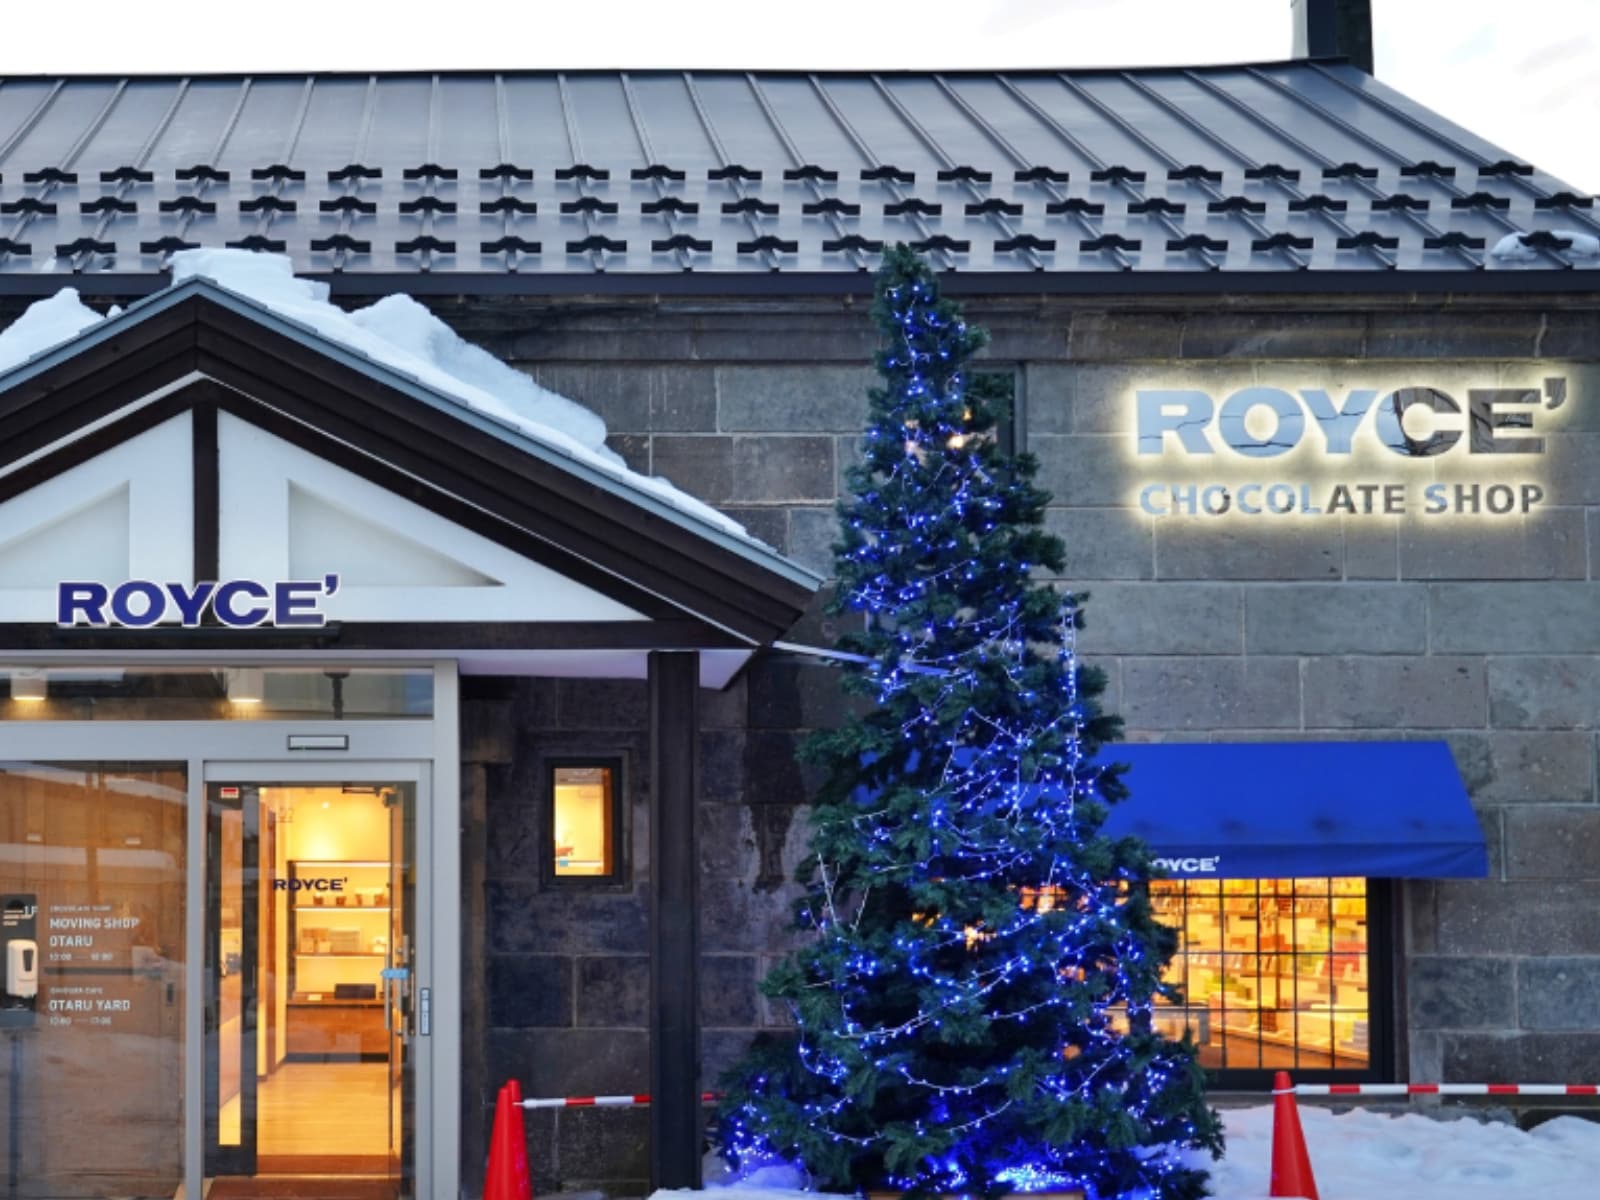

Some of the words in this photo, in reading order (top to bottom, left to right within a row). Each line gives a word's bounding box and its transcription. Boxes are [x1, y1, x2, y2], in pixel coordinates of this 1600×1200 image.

[1139, 483, 1406, 515] CHOCOLATE
[1424, 483, 1544, 514] SHOP
[49, 918, 101, 929] MOVING
[104, 917, 140, 929] SHOP
[49, 935, 93, 946] OTARU
[48, 999, 93, 1011] OTARU
[96, 1000, 131, 1011] YARD
